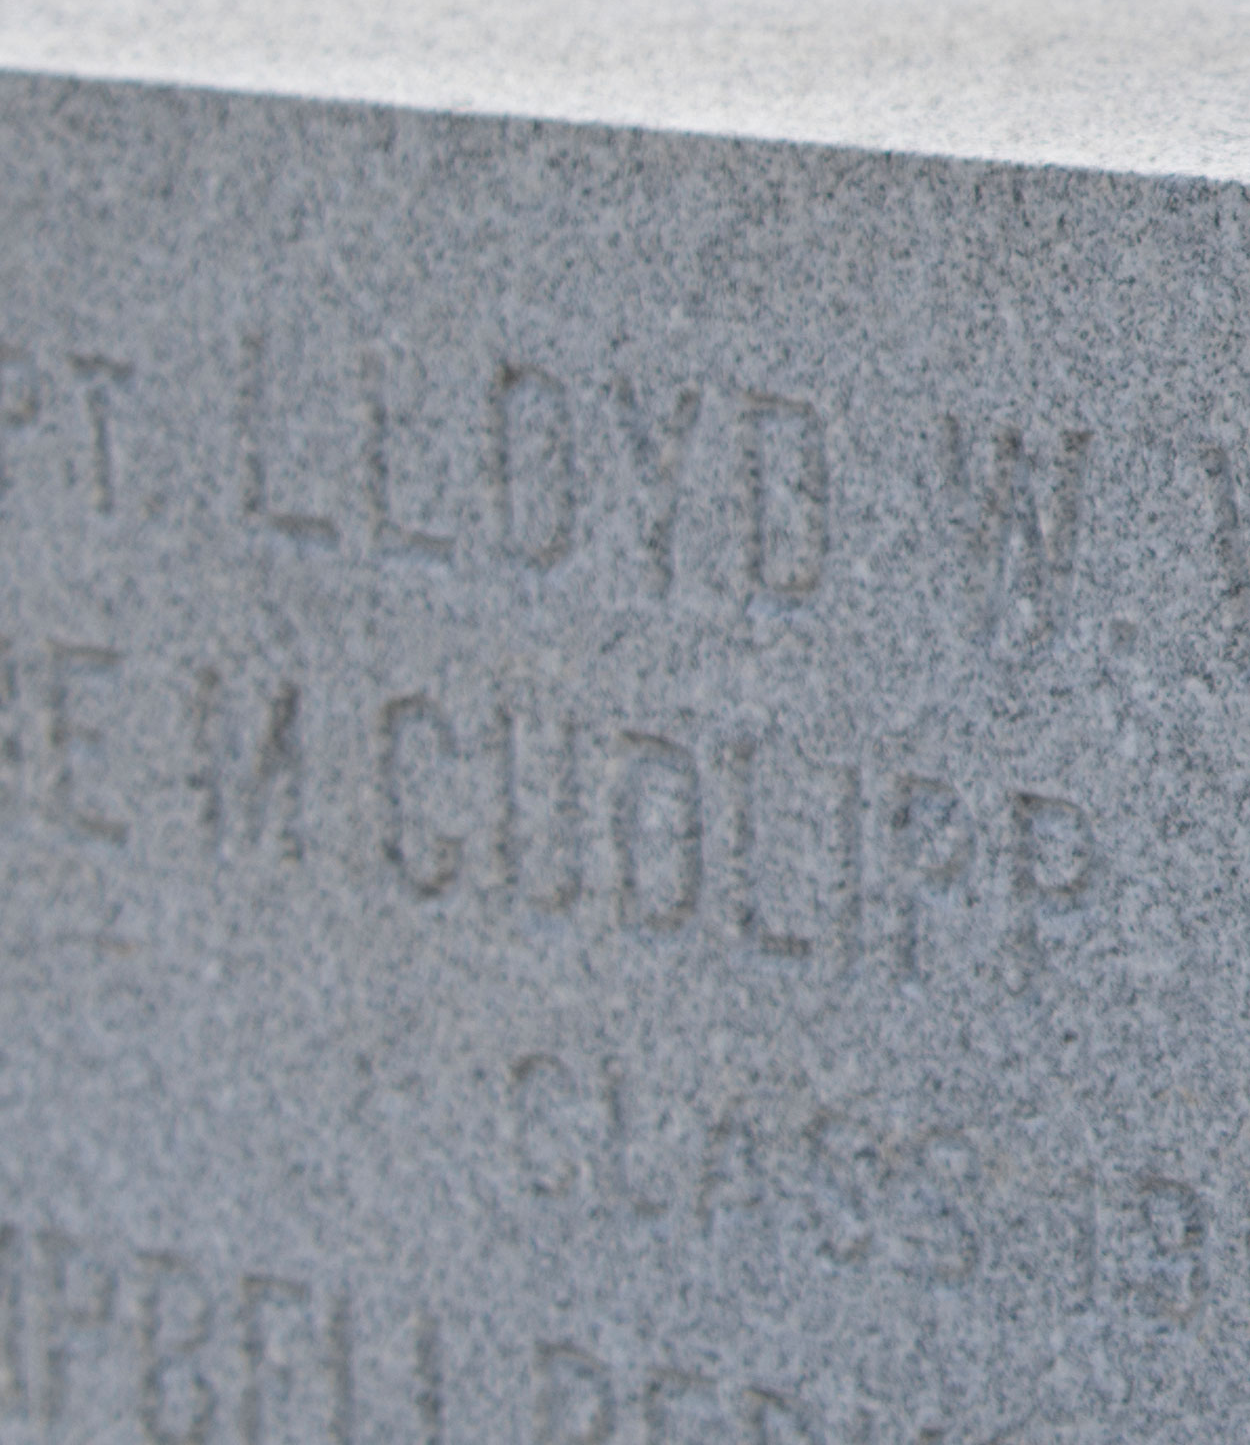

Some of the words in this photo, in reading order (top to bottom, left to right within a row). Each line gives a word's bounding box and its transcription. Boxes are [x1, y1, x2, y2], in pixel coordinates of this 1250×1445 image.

[238, 321, 838, 605] LLOYD
[372, 689, 1105, 999] CUDLIPP
[508, 1047, 985, 1287] CLASS
